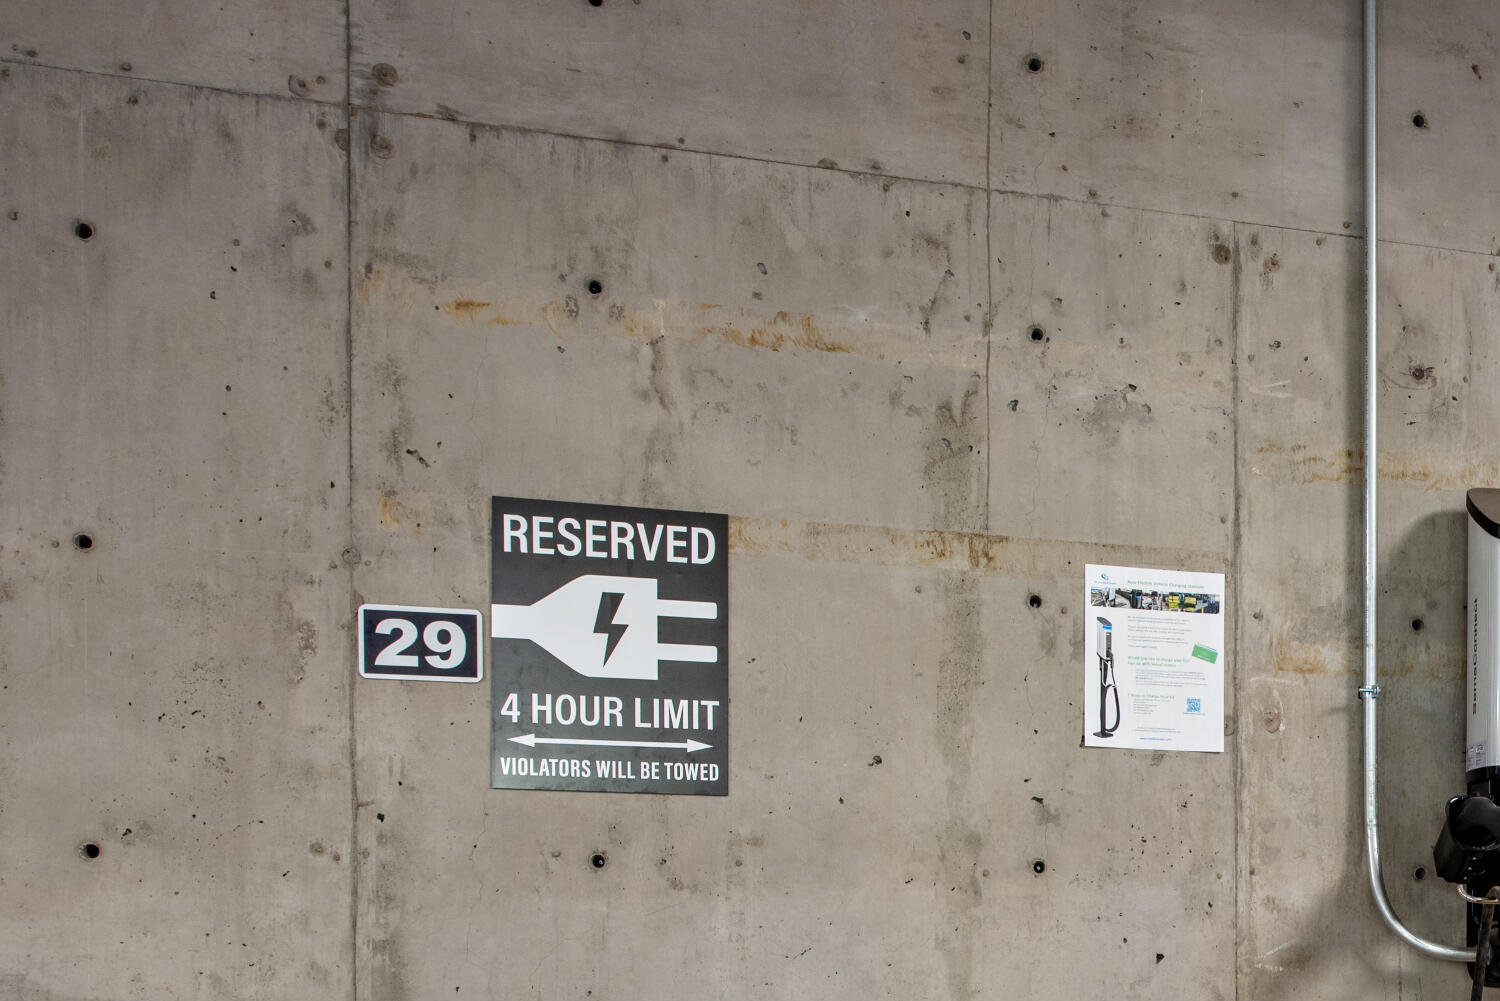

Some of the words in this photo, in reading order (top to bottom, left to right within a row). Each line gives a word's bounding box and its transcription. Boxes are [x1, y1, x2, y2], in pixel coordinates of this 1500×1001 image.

[503, 514, 716, 565] RESERVED
[374, 618, 468, 670] 29
[500, 692, 521, 724] 4
[531, 693, 624, 728] HOUR
[634, 697, 720, 731] LIMIT
[500, 757, 591, 779] VIOLATORS
[595, 760, 636, 780] WILL
[640, 762, 660, 780] BE
[664, 763, 719, 782] TOWED
